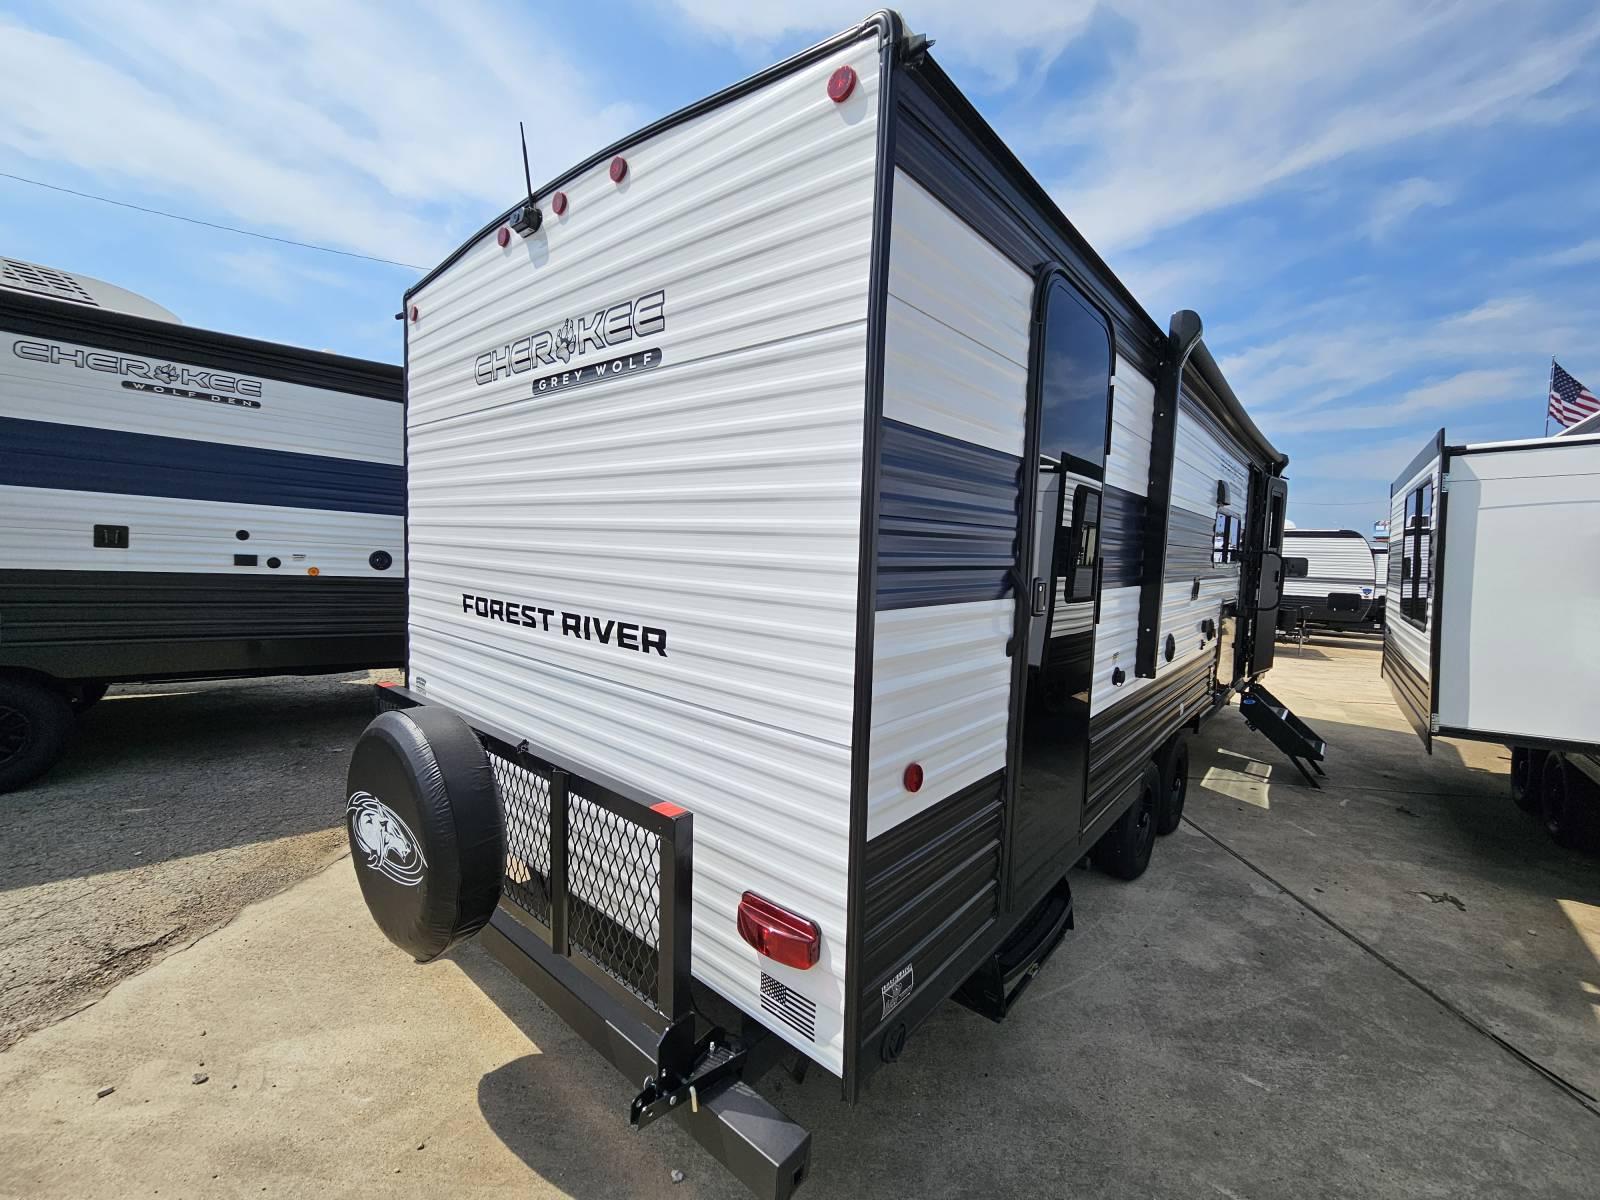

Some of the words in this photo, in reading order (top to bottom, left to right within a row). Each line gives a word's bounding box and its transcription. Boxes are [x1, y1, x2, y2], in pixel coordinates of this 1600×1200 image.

[538, 370, 582, 391] GREY
[595, 352, 653, 376] WOLF
[132, 382, 197, 398] WOLF
[210, 394, 253, 408] DEN
[462, 593, 554, 632] FOREST
[561, 611, 668, 657] RIVER
